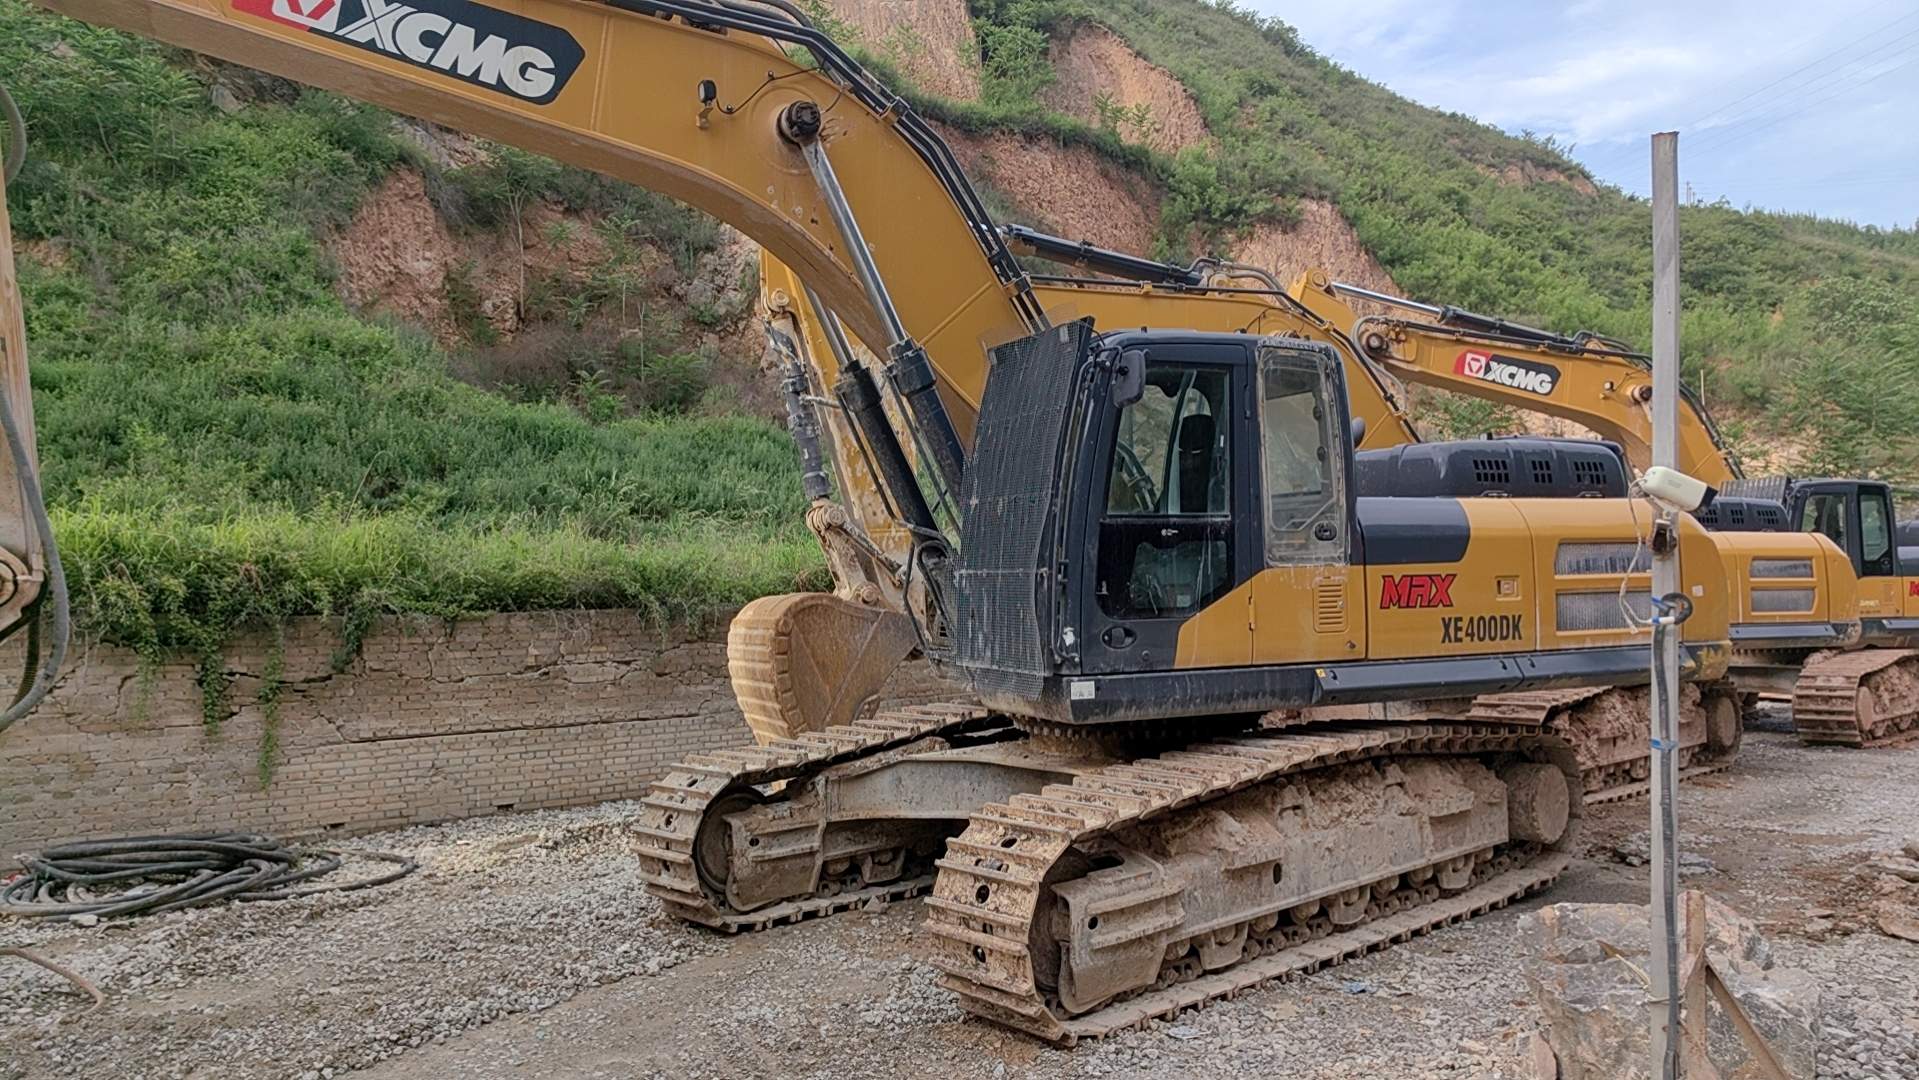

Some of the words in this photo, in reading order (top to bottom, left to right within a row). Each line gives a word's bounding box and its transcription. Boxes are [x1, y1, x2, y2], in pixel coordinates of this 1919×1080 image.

[334, 0, 556, 98] XCMG
[1484, 361, 1552, 394] XCMG
[1380, 574, 1457, 609] MAX
[1441, 615, 1522, 643] XE400DK
